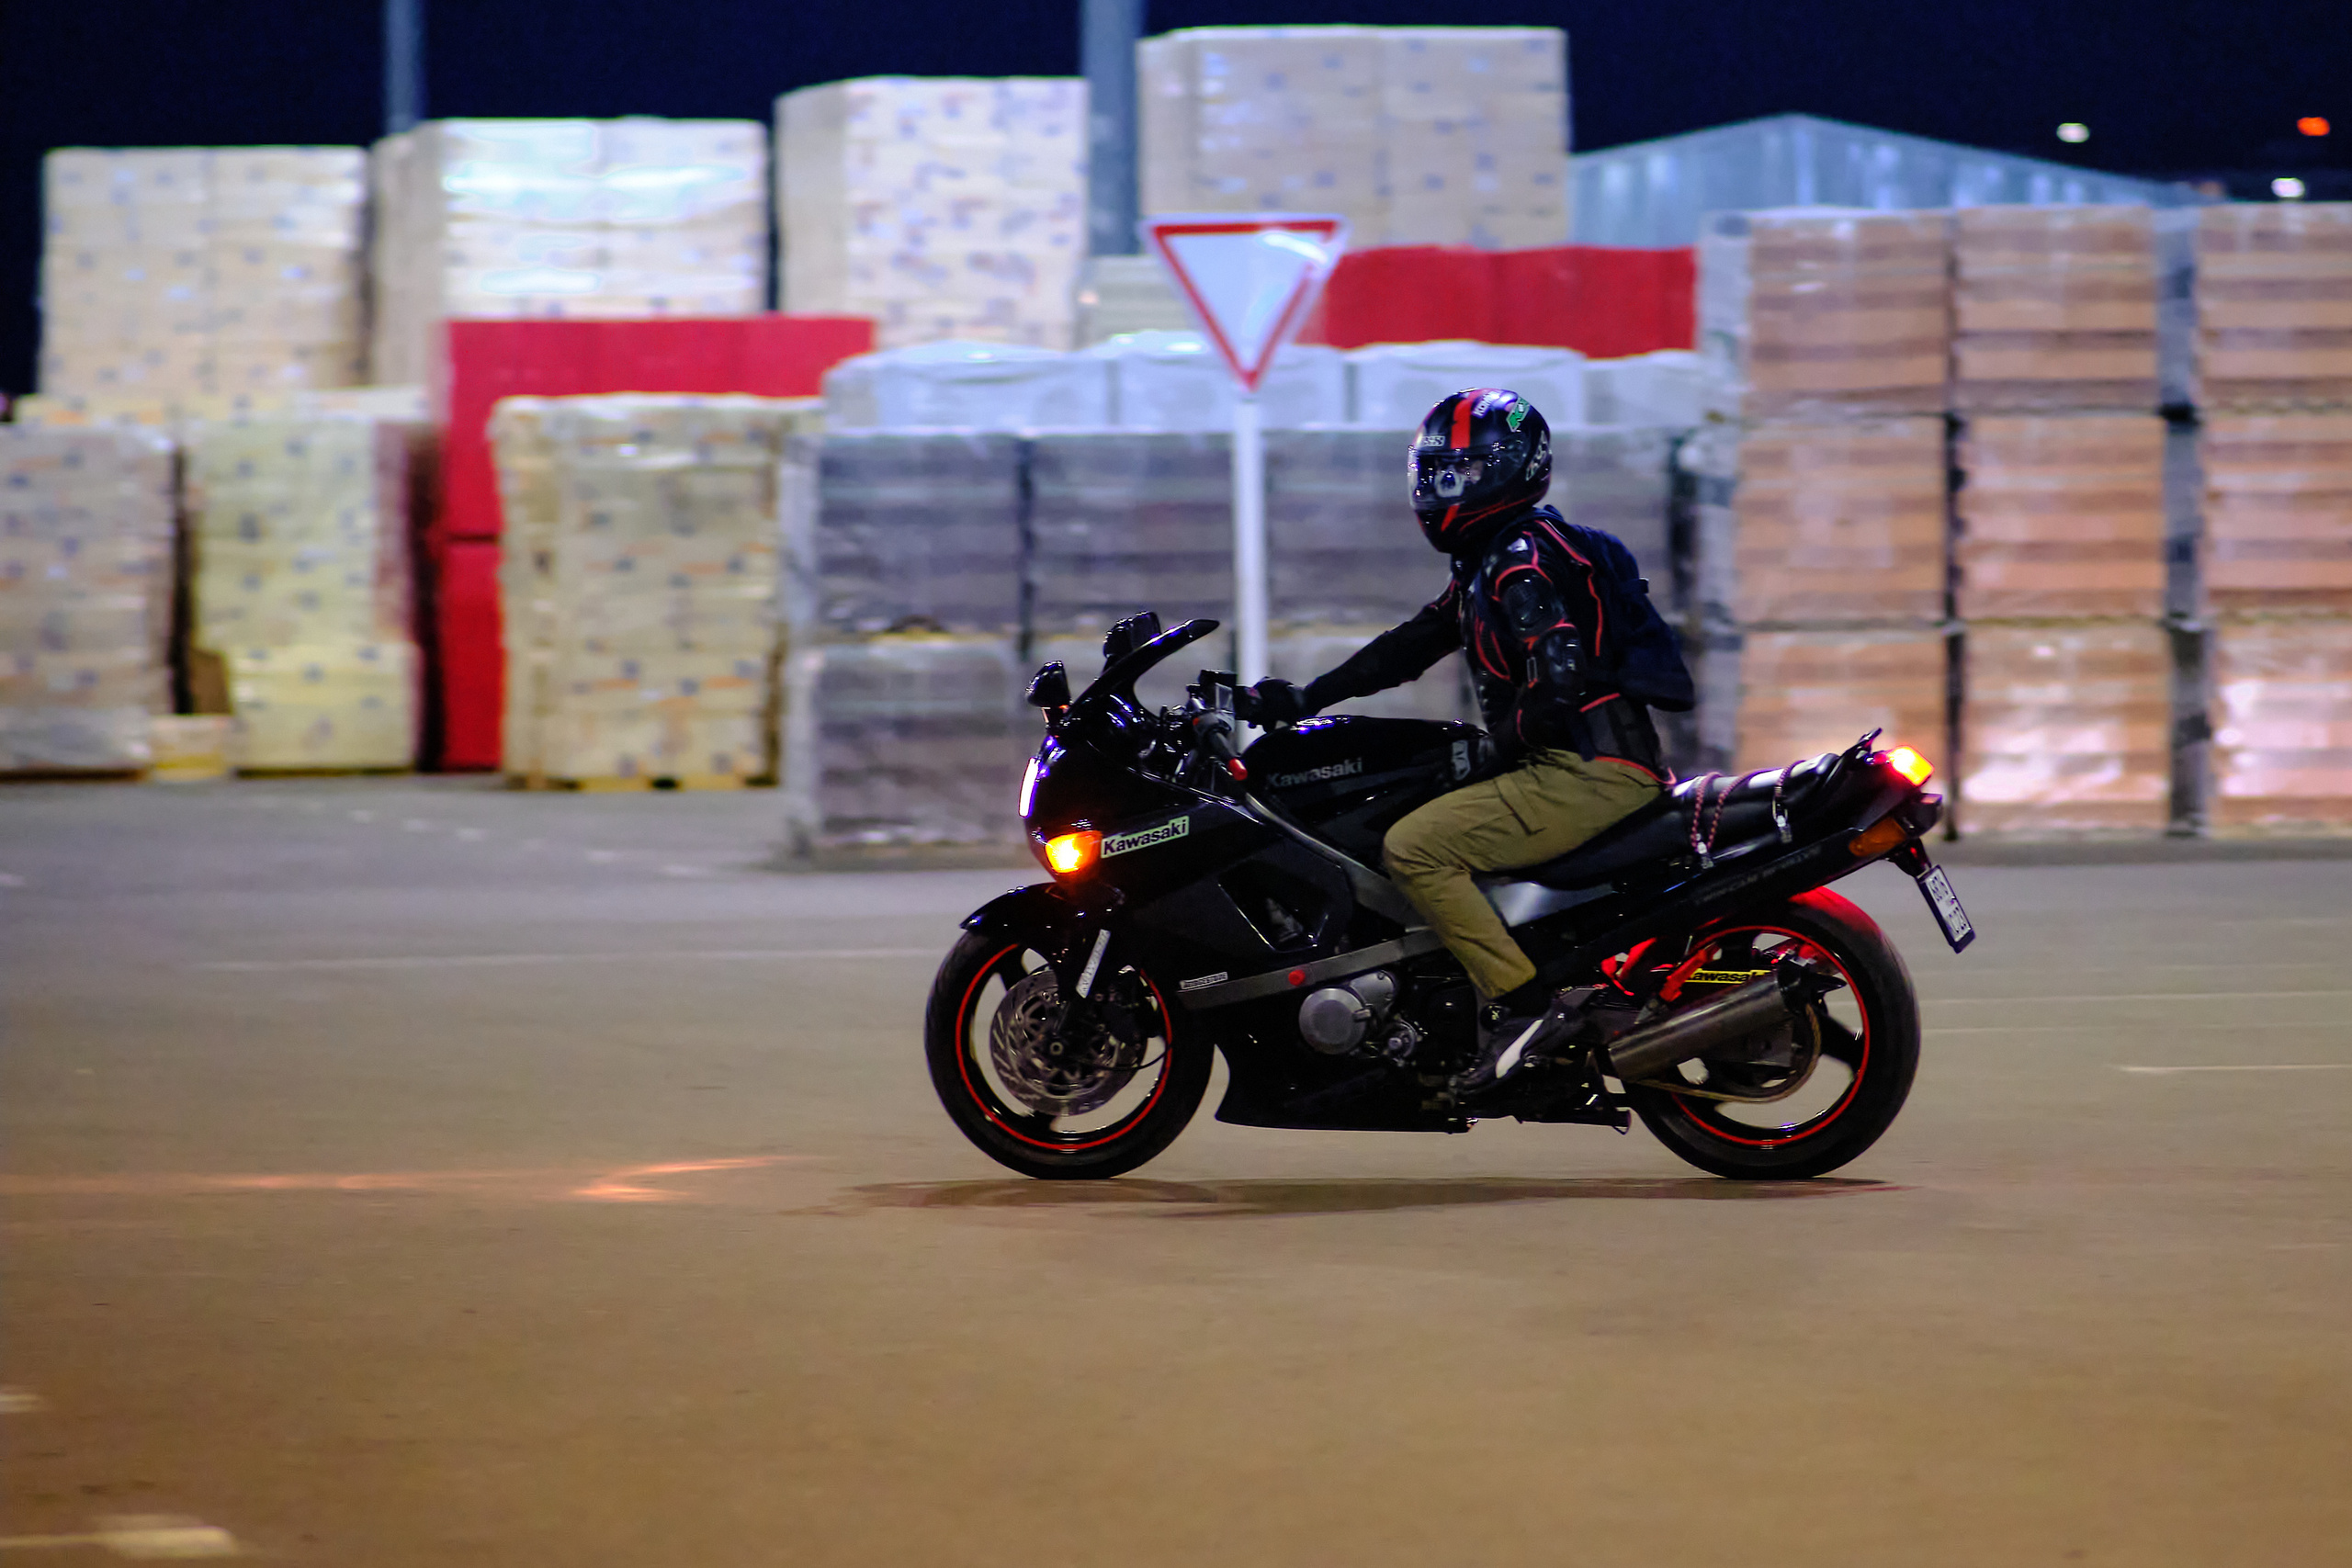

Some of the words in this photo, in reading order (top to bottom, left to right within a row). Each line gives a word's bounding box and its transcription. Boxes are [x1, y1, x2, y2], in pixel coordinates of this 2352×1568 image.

[1268, 757, 1363, 787] Kawasaki
[1103, 818, 1187, 855] Kawasaki
[1692, 970, 1756, 982] awasa
